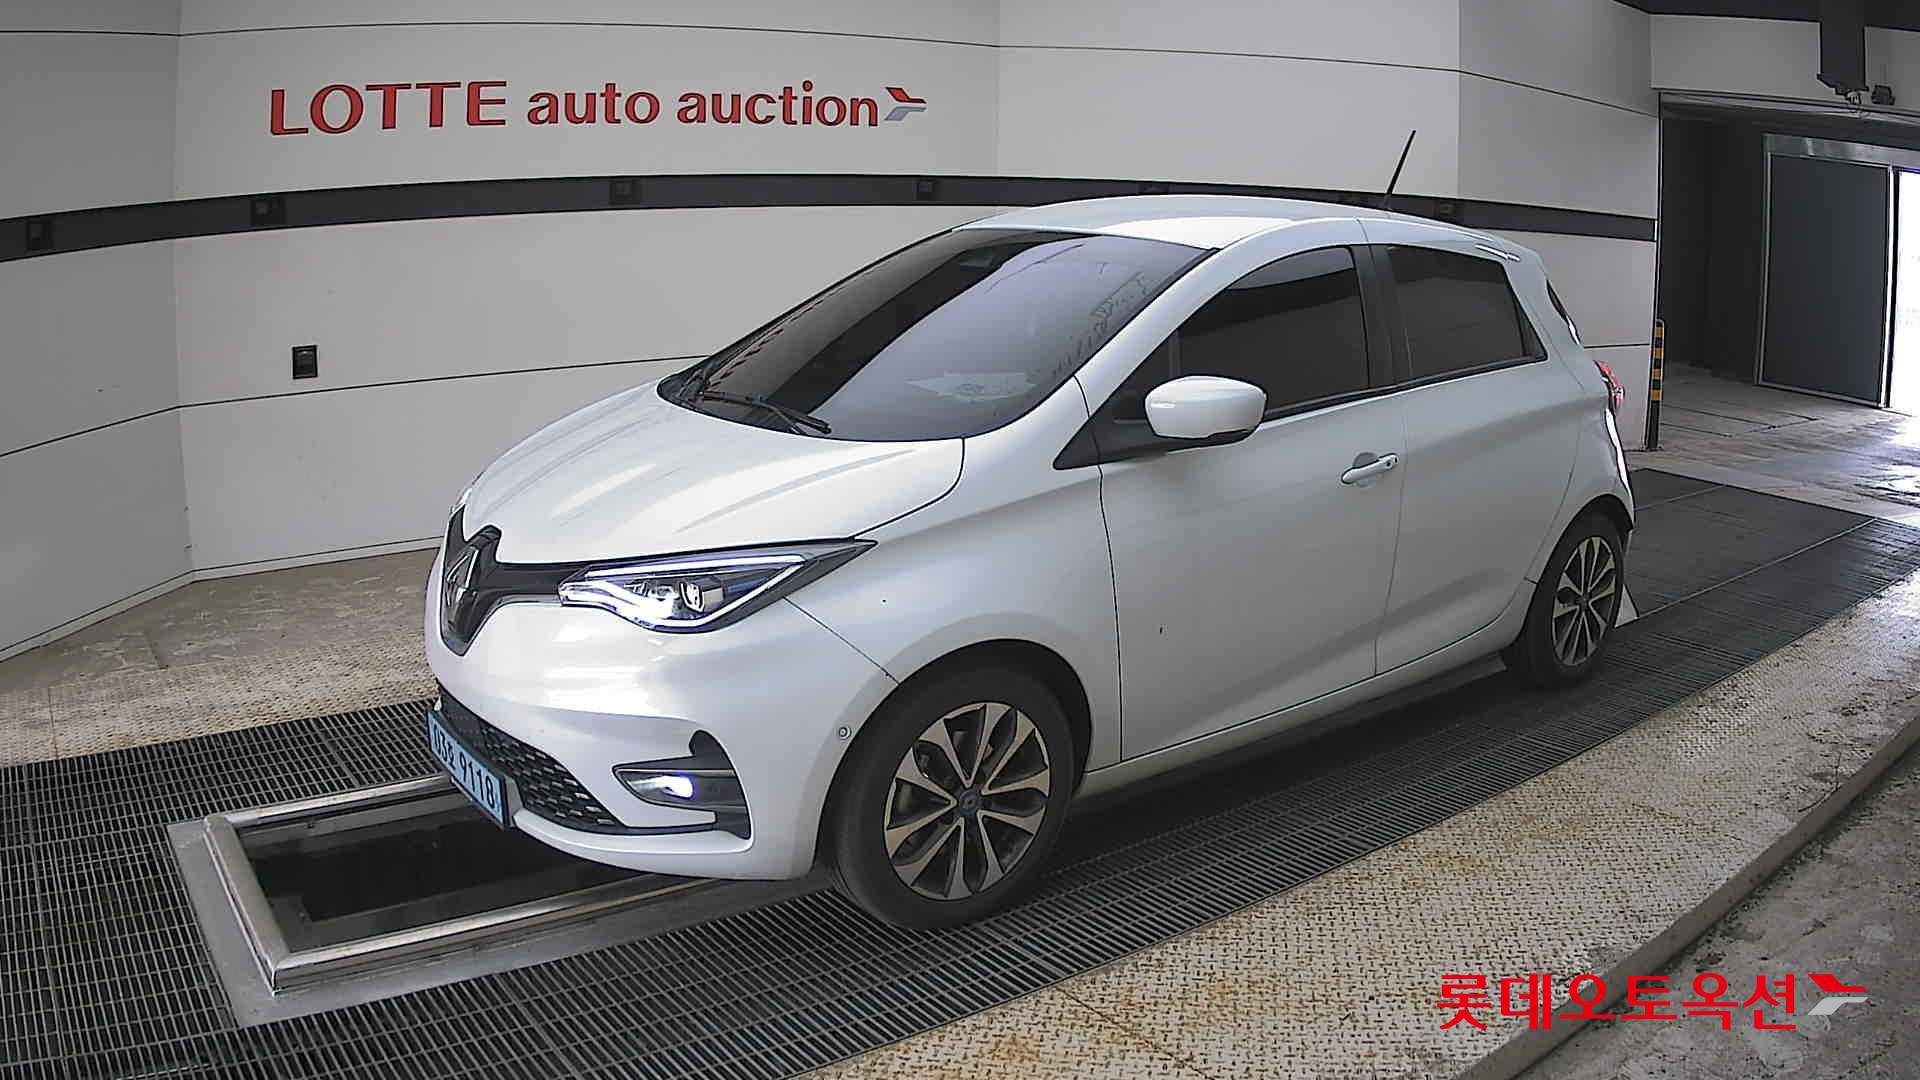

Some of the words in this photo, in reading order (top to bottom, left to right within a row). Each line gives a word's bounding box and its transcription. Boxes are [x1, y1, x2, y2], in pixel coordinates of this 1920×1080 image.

[270, 80, 507, 136] LOTTE
[527, 82, 661, 126] auto
[677, 80, 879, 127] auction
[460, 751, 496, 809] 9118
